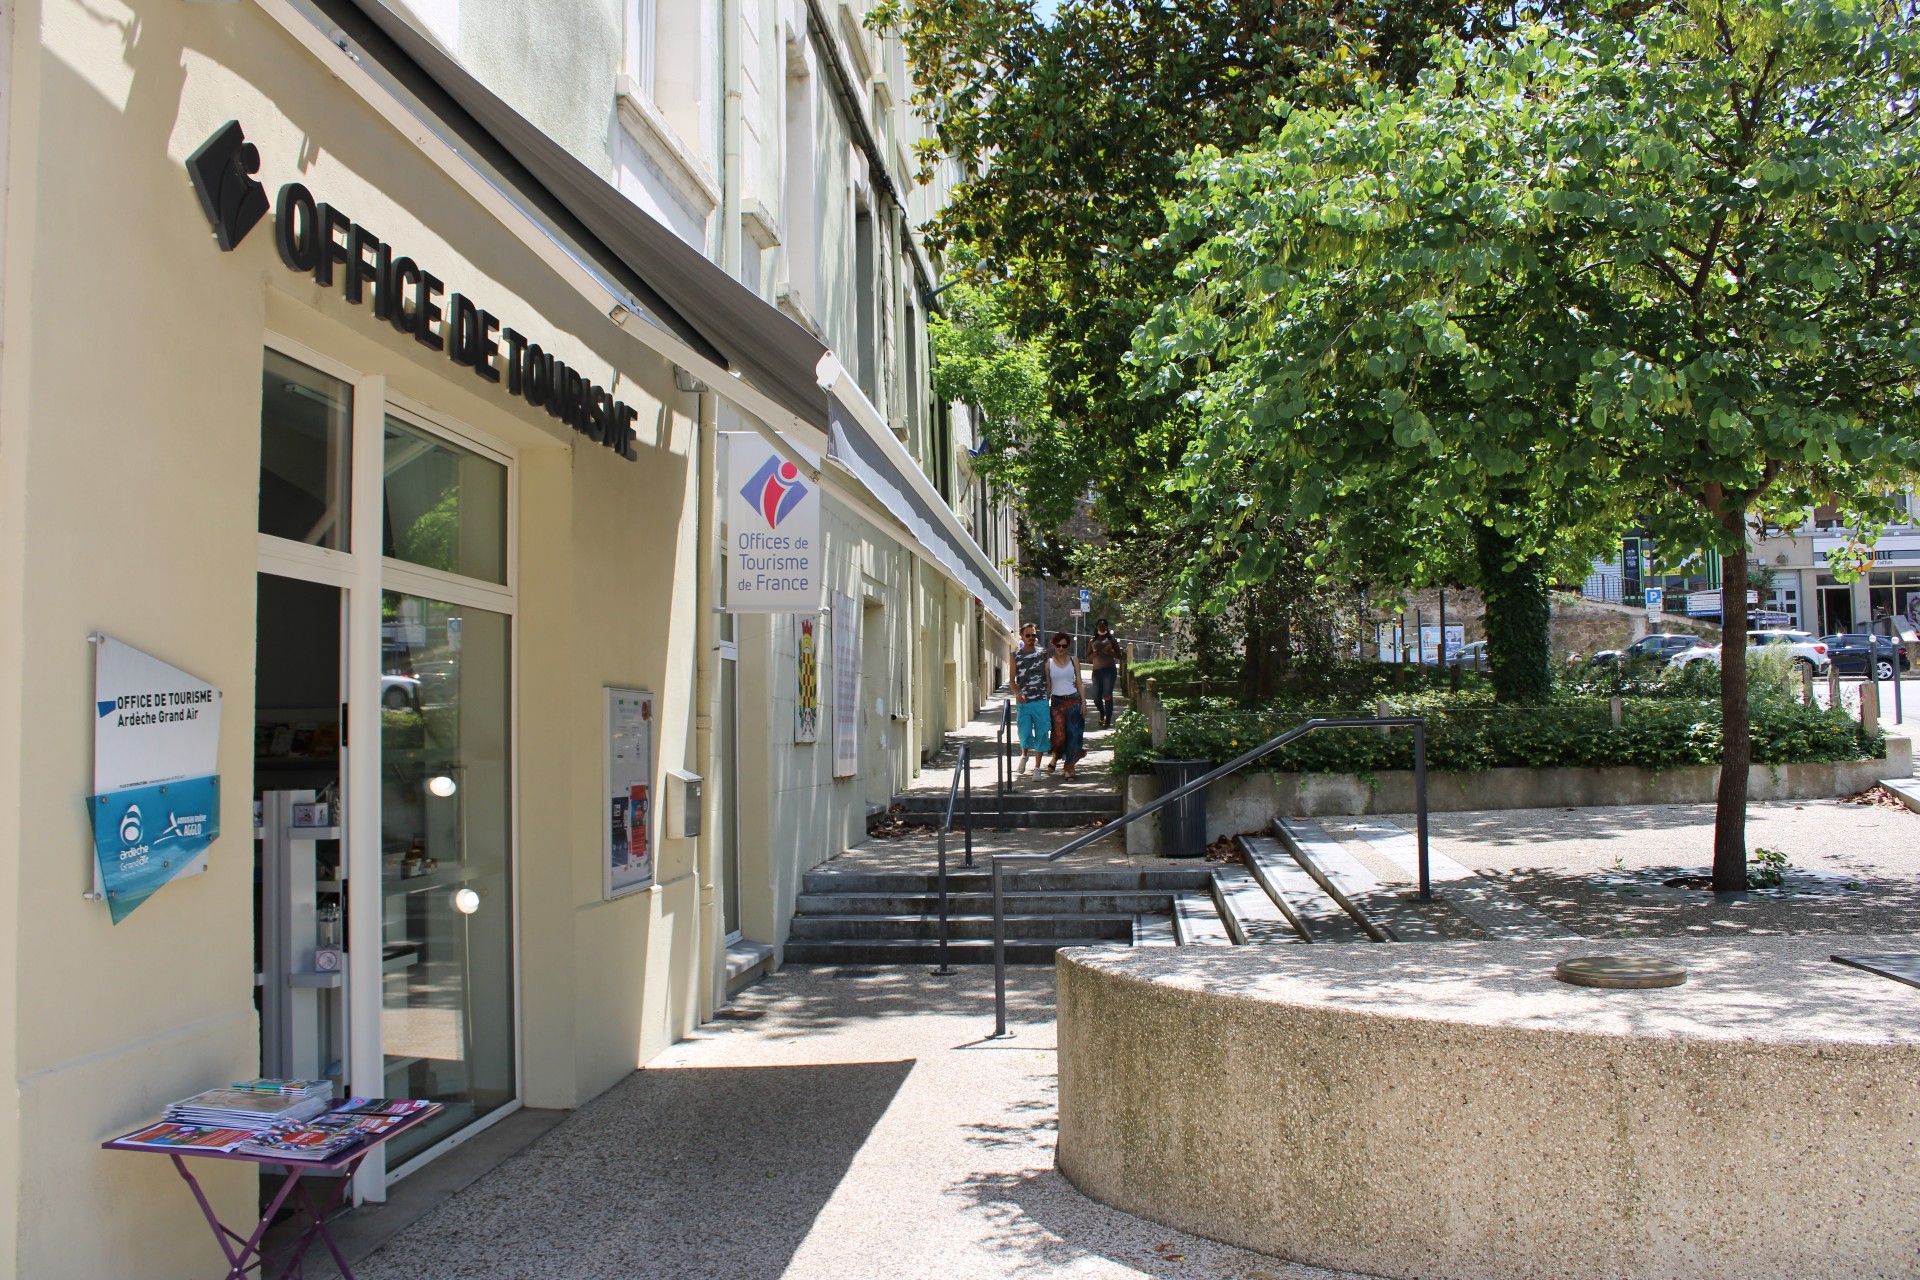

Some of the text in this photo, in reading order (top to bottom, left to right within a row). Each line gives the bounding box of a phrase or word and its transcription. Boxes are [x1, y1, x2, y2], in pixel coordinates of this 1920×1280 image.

[276, 183, 638, 462] OFFICE DE TOURISME
[739, 533, 808, 549] Offices de
[739, 554, 808, 570] Tourisme
[738, 574, 808, 591] de France
[1650, 591, 1658, 602] P
[117, 689, 212, 710] OFFICE DE TOURISME
[118, 707, 199, 727] Ardèche Grand Air
